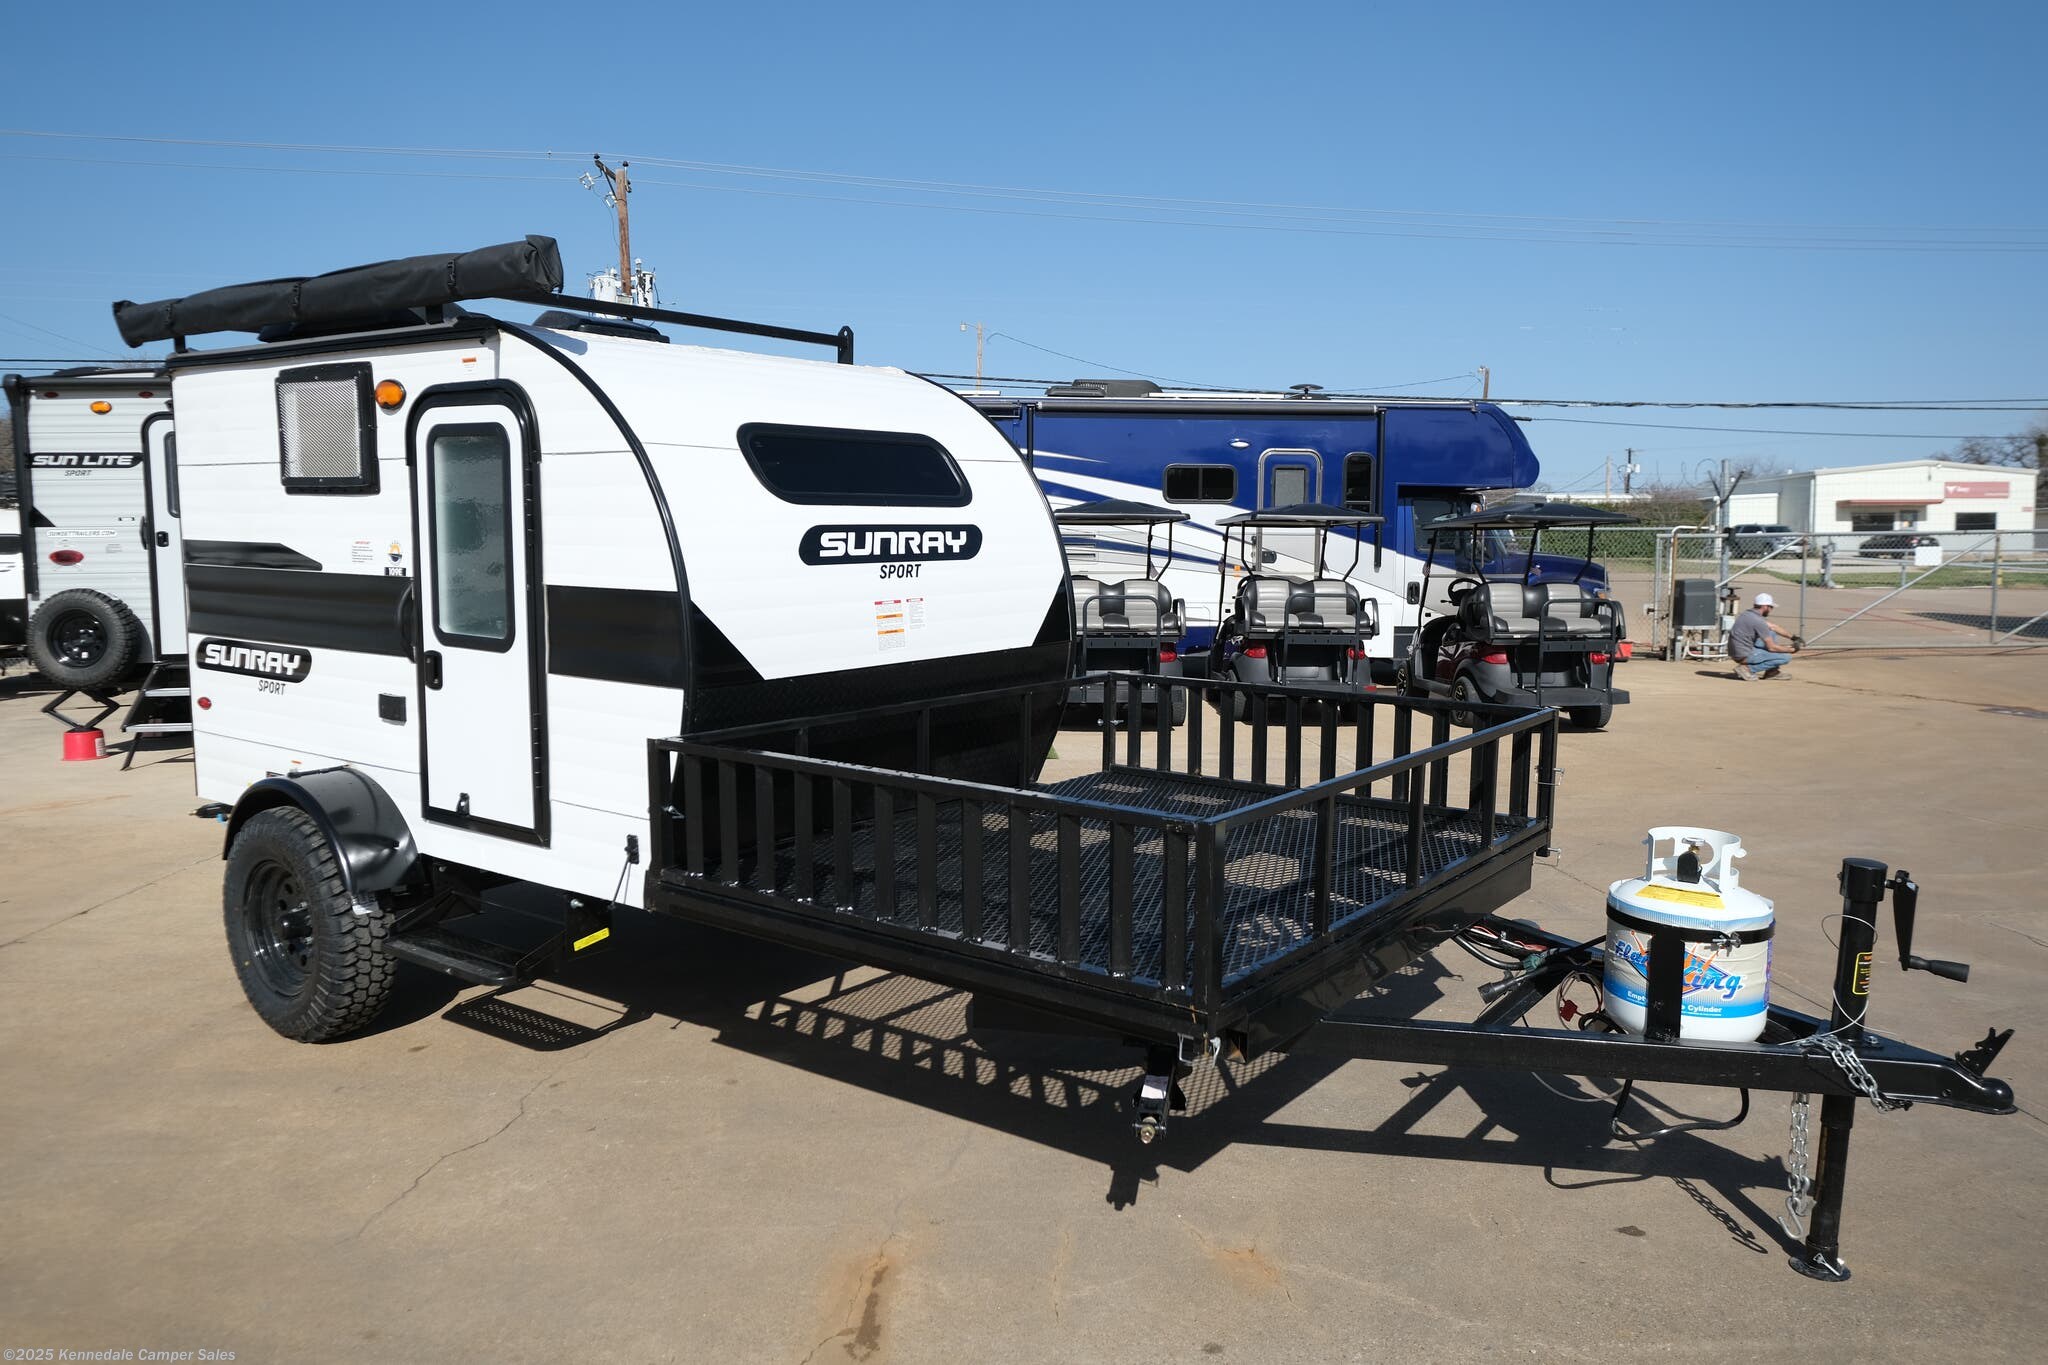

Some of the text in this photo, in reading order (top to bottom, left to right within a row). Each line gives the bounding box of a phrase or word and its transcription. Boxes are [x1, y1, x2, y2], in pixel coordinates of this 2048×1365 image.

[32, 455, 134, 466] SUN LITE
[64, 469, 92, 477] SPORT
[819, 530, 968, 558] SUNRAY
[879, 563, 922, 579] SPORT
[204, 643, 301, 676] SUNRAY
[258, 679, 286, 695] SPORT
[1627, 990, 1647, 1002] Empt
[1688, 1004, 1722, 1013] Cylinder
